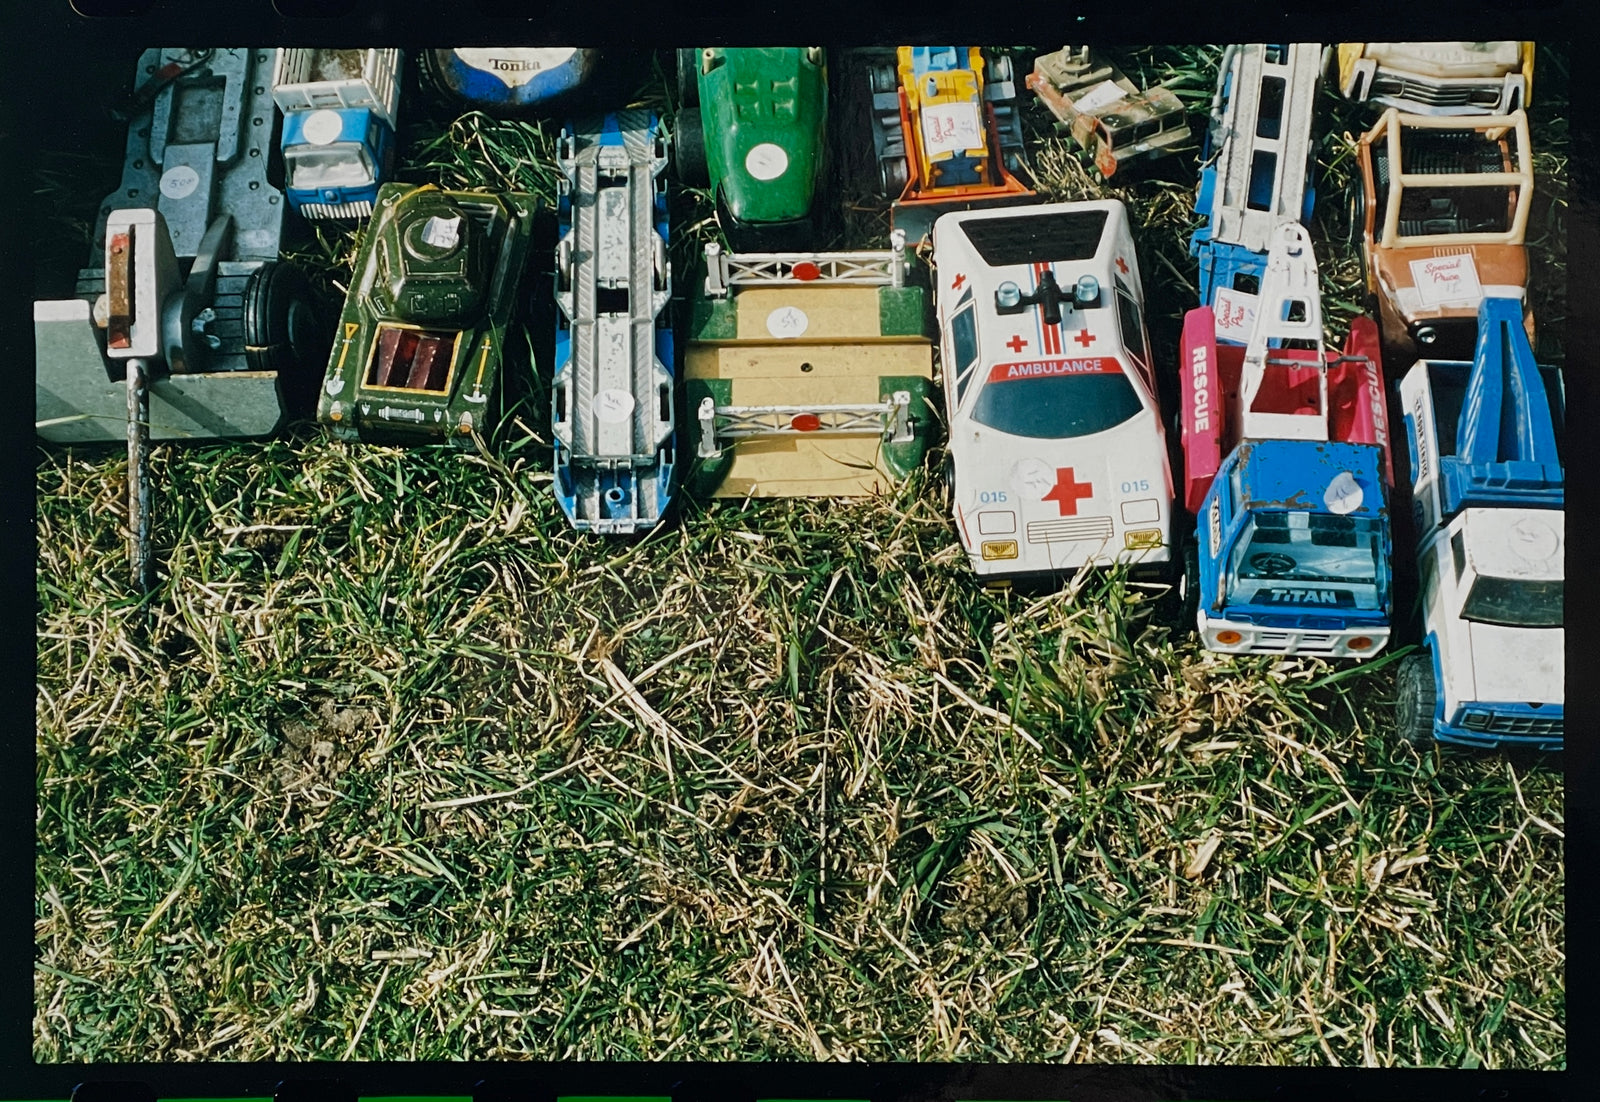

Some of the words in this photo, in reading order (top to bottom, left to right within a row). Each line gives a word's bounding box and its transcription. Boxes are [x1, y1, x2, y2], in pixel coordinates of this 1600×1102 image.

[488, 58, 541, 71] Tonka
[1424, 258, 1461, 276] Special
[1433, 272, 1460, 283] Price
[1217, 296, 1231, 329] Special
[1231, 305, 1244, 327] Price
[1007, 359, 1102, 377] AMBULANCE
[1192, 346, 1209, 434] RESCUE
[1365, 360, 1387, 447] RESCUE
[1121, 479, 1149, 493] 015
[980, 491, 1007, 503] 015
